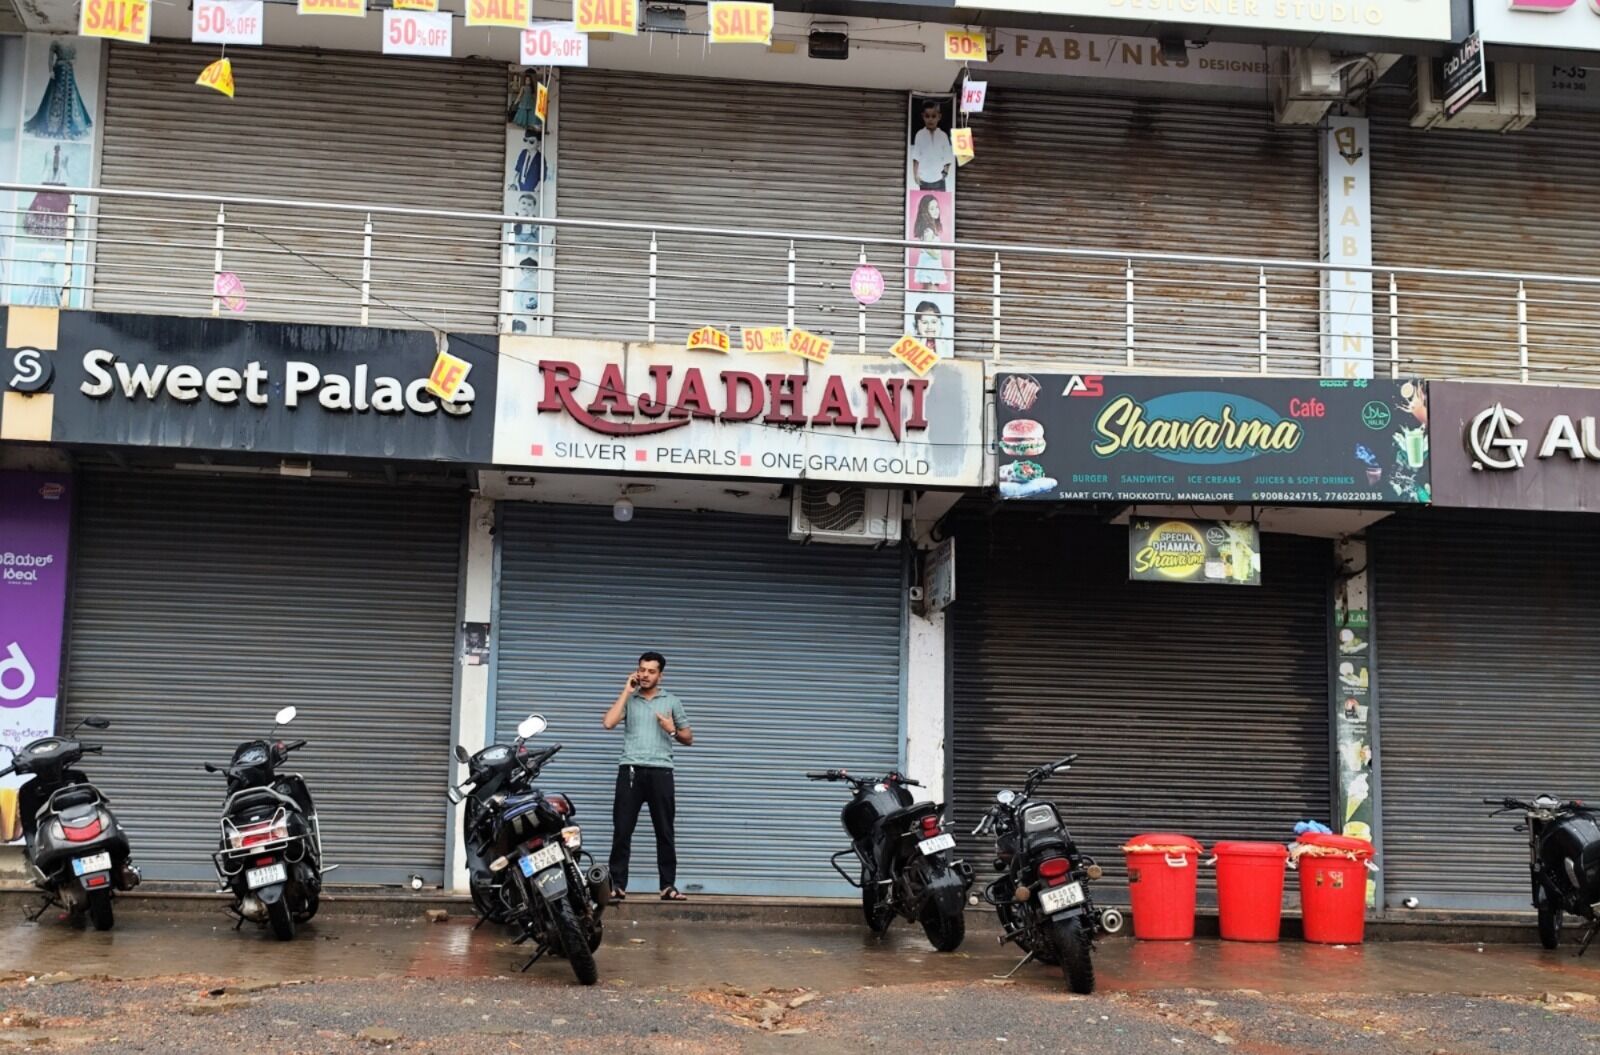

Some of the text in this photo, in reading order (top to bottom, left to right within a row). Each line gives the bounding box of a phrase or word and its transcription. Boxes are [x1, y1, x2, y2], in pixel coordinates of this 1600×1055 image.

[86, 0, 144, 34] SALE
[198, 6, 257, 35] 50% OFF
[471, 0, 526, 21] SALE
[579, 0, 633, 27] SALE
[715, 10, 768, 36] SALE
[1274, 2, 1384, 24] STUDIO
[389, 19, 447, 46] 50% OFF
[525, 29, 582, 57] 50% OFF
[1199, 58, 1270, 74] DESIGNER
[691, 330, 727, 349] SALE
[789, 330, 829, 360] SALE
[896, 338, 935, 372] SALE
[80, 349, 476, 415] Sweet Palace
[537, 360, 929, 444] RAJADHANI
[1290, 398, 1325, 417] Cafe
[1095, 396, 1301, 455] Shawarma
[555, 442, 929, 475] SILVER PEARLS ONE GRAM GOLD
[1072, 474, 1108, 484] BURGER
[1121, 475, 1175, 484] SANDWITCH
[1188, 475, 1201, 484] ICE
[1205, 475, 1242, 484] CREAMS
[1254, 476, 1285, 484] JUICES
[1297, 476, 1319, 484] SOFT
[1322, 476, 1355, 485] DRINKS
[1059, 491, 1090, 499] SMART
[1092, 492, 1115, 501] CITY,
[1117, 492, 1175, 501] THOKKOTTU,
[1178, 492, 1234, 501] MANGALORE
[1325, 492, 1383, 501] 7760220385
[1153, 541, 1203, 553] DHAMAKA
[1160, 532, 1195, 543] SPECIAL
[1337, 613, 1368, 623] HLAL
